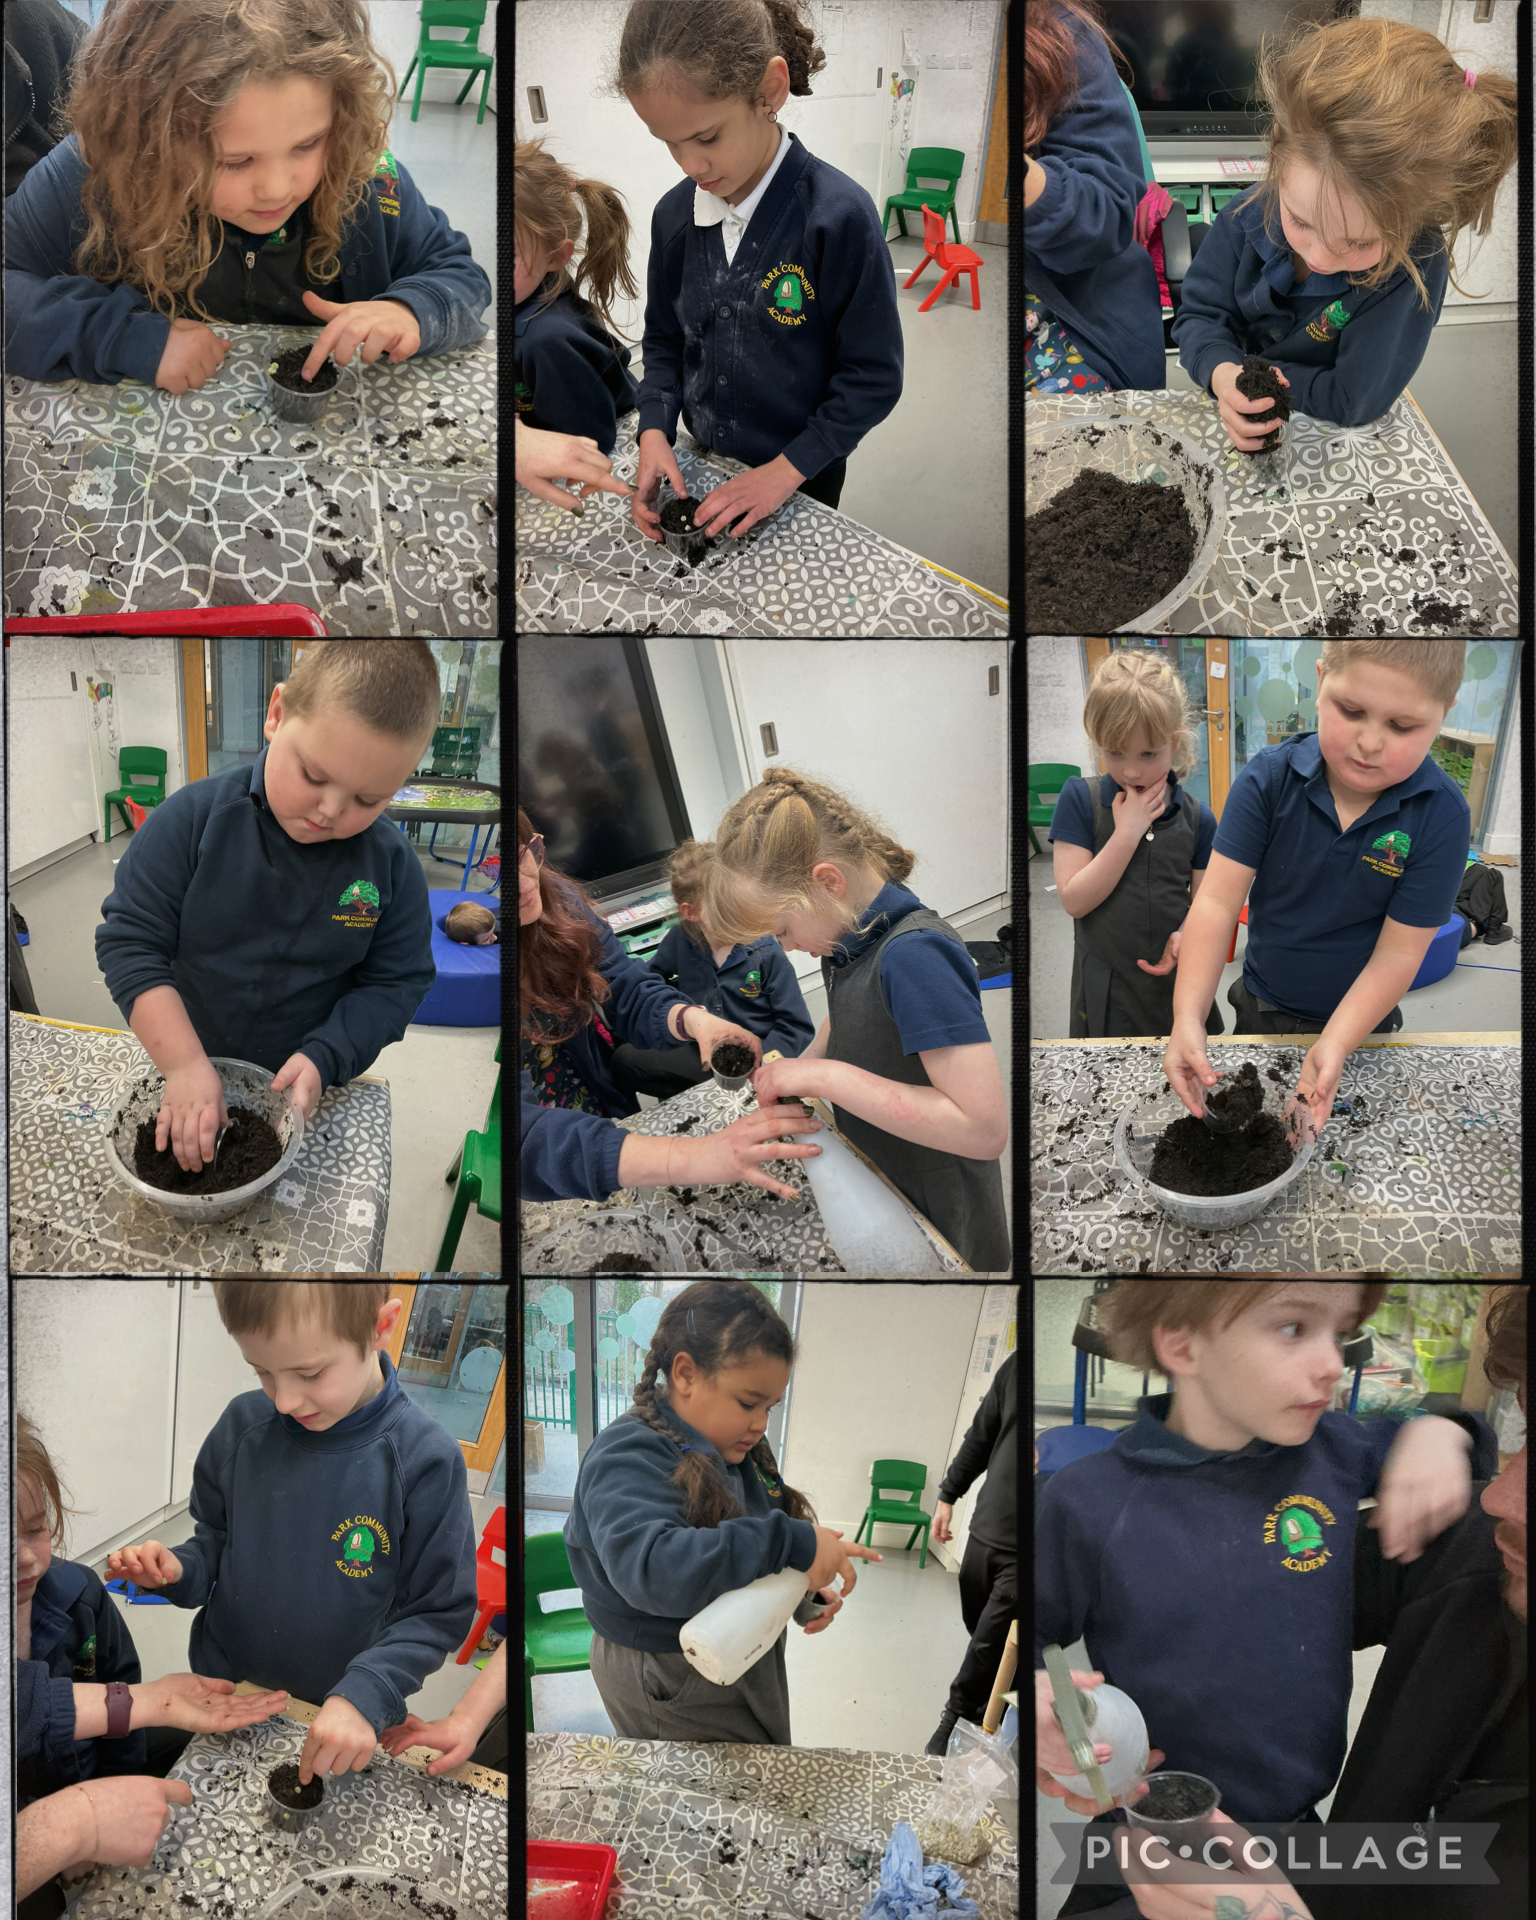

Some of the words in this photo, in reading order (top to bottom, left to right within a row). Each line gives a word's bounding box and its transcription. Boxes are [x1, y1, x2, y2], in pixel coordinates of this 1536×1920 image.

[761, 267, 781, 290] PARK
[781, 264, 816, 301] COMMUNITY
[767, 307, 807, 326] ACADEMY
[1361, 855, 1378, 865] PARK
[331, 914, 350, 922] PARK
[331, 1518, 354, 1541] PARK
[354, 1515, 390, 1556] COMMUNITY
[1263, 1513, 1280, 1544] PARK
[335, 1560, 373, 1578] ACADEMY
[1281, 1547, 1333, 1572] ACADEMY
